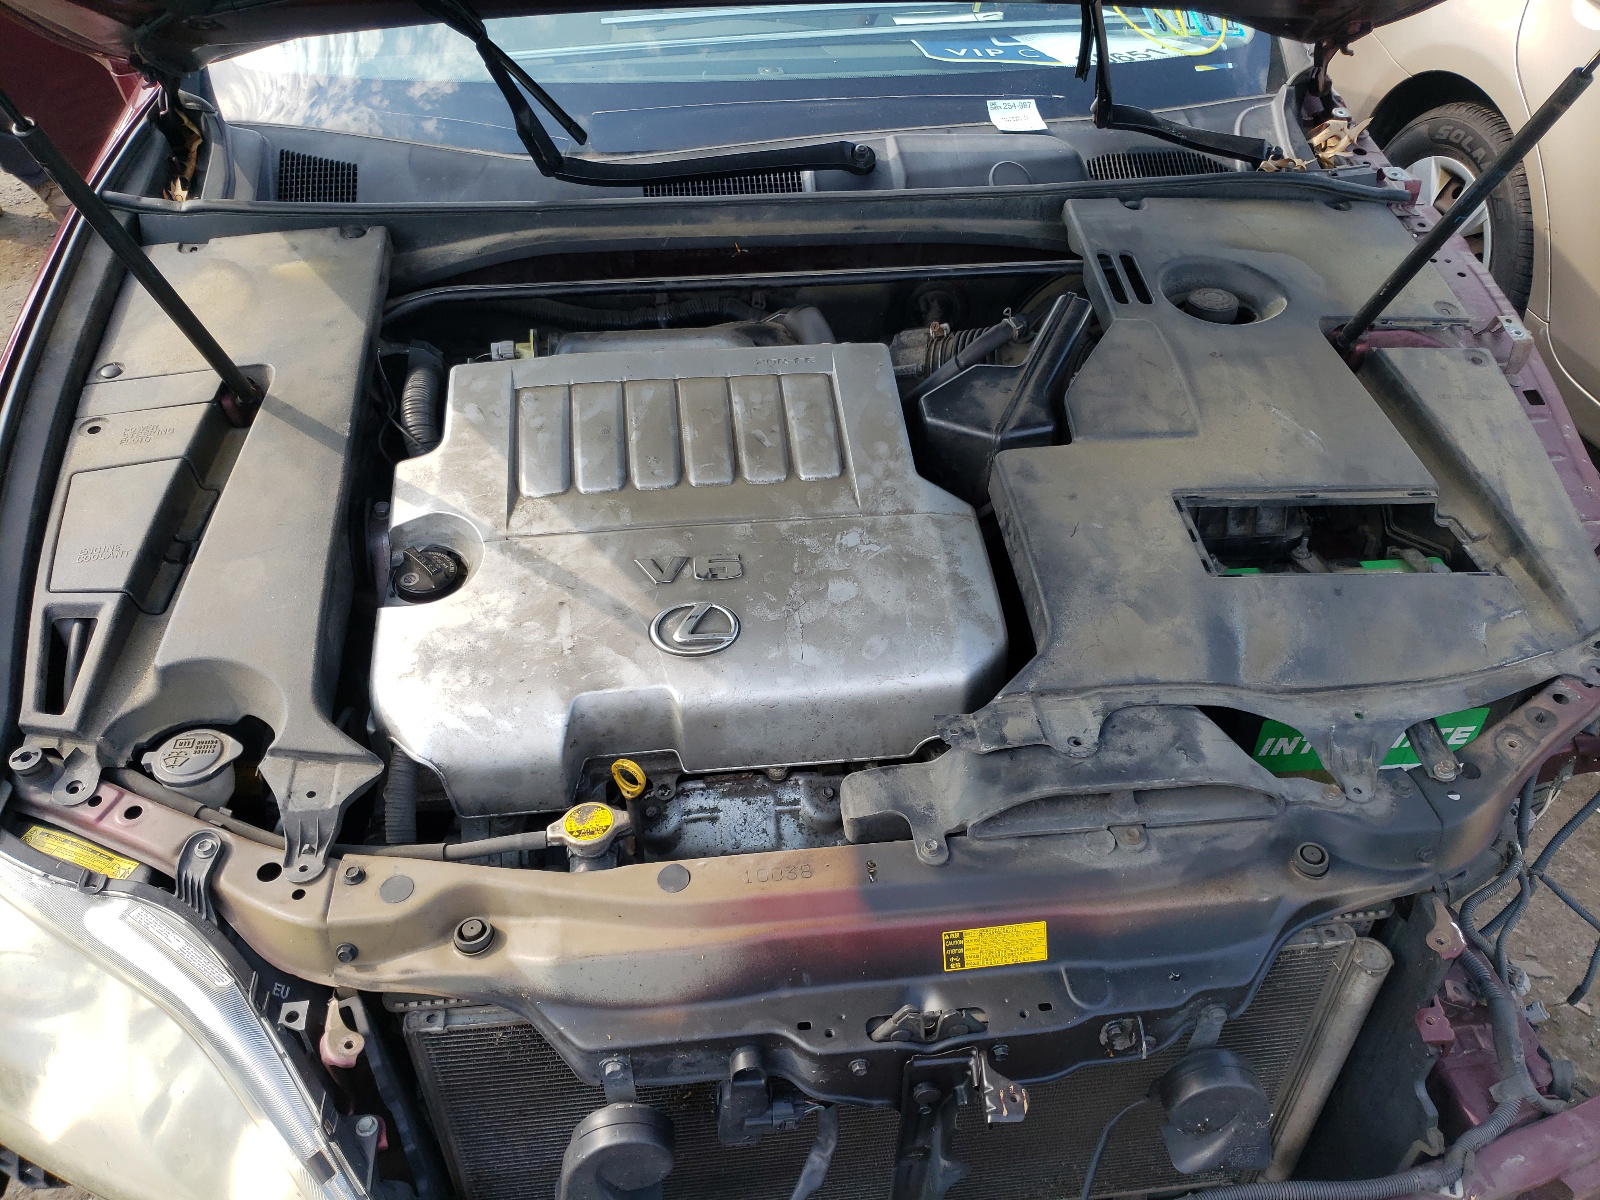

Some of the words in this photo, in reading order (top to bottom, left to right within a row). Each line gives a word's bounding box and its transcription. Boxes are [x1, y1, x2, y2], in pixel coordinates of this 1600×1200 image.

[945, 48, 1004, 57] VIP
[76, 550, 132, 563] COOLANT
[634, 554, 744, 585] V6
[746, 863, 813, 884] 10038
